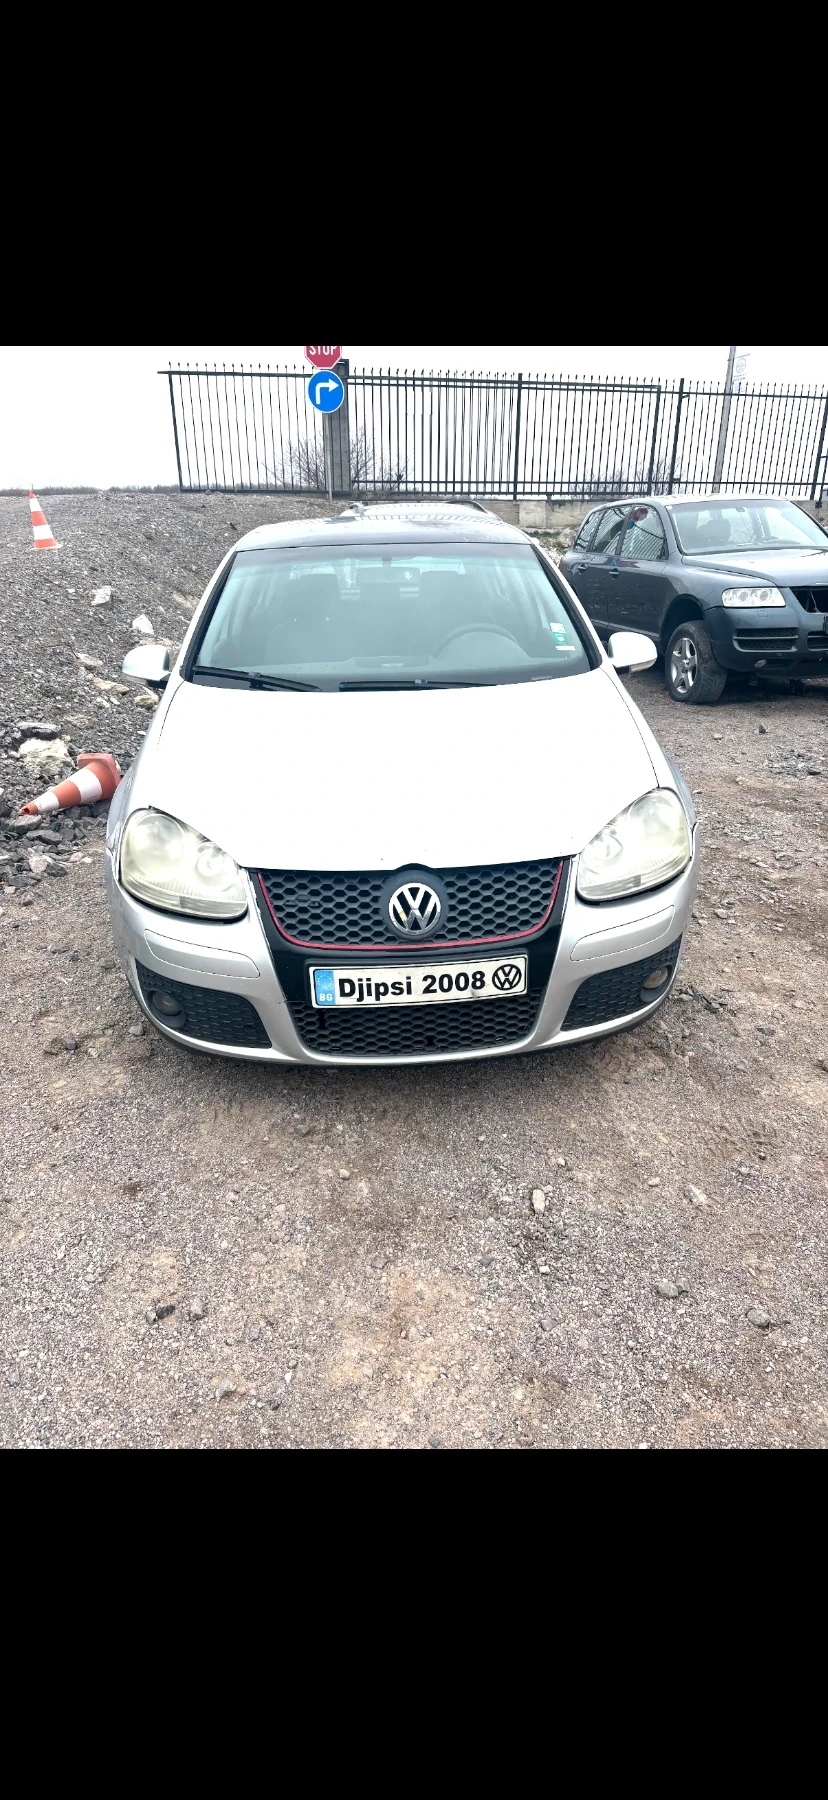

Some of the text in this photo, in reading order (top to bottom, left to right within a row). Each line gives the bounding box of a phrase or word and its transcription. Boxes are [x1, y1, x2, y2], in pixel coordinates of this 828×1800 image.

[338, 976, 412, 1002] Djipsi
[422, 971, 486, 995] 2008
[319, 993, 333, 1002] BG
